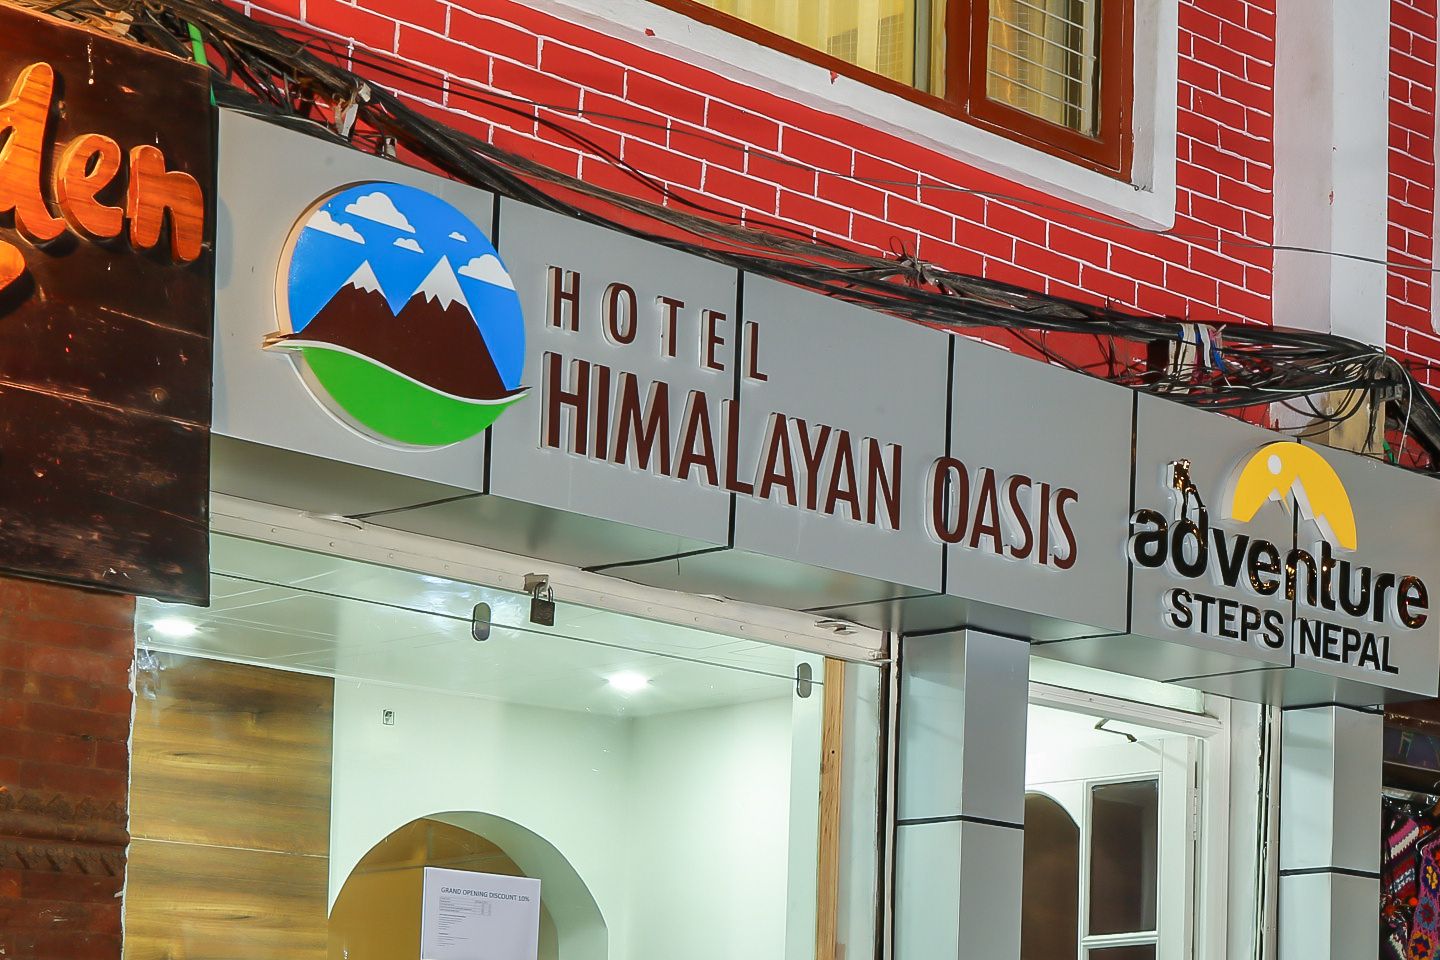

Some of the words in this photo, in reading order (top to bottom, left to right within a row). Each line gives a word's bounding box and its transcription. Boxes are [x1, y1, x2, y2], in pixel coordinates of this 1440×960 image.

[546, 264, 768, 382] HOTEL
[541, 351, 903, 531] HIMALAYAN
[926, 457, 1079, 570] OASIS
[1129, 506, 1429, 629] adventure
[1164, 587, 1285, 649] STEPS
[1295, 617, 1399, 675] NEPAL
[441, 886, 461, 895] GRAND
[463, 889, 488, 898] OPENING
[489, 892, 517, 901] DISCOUNT
